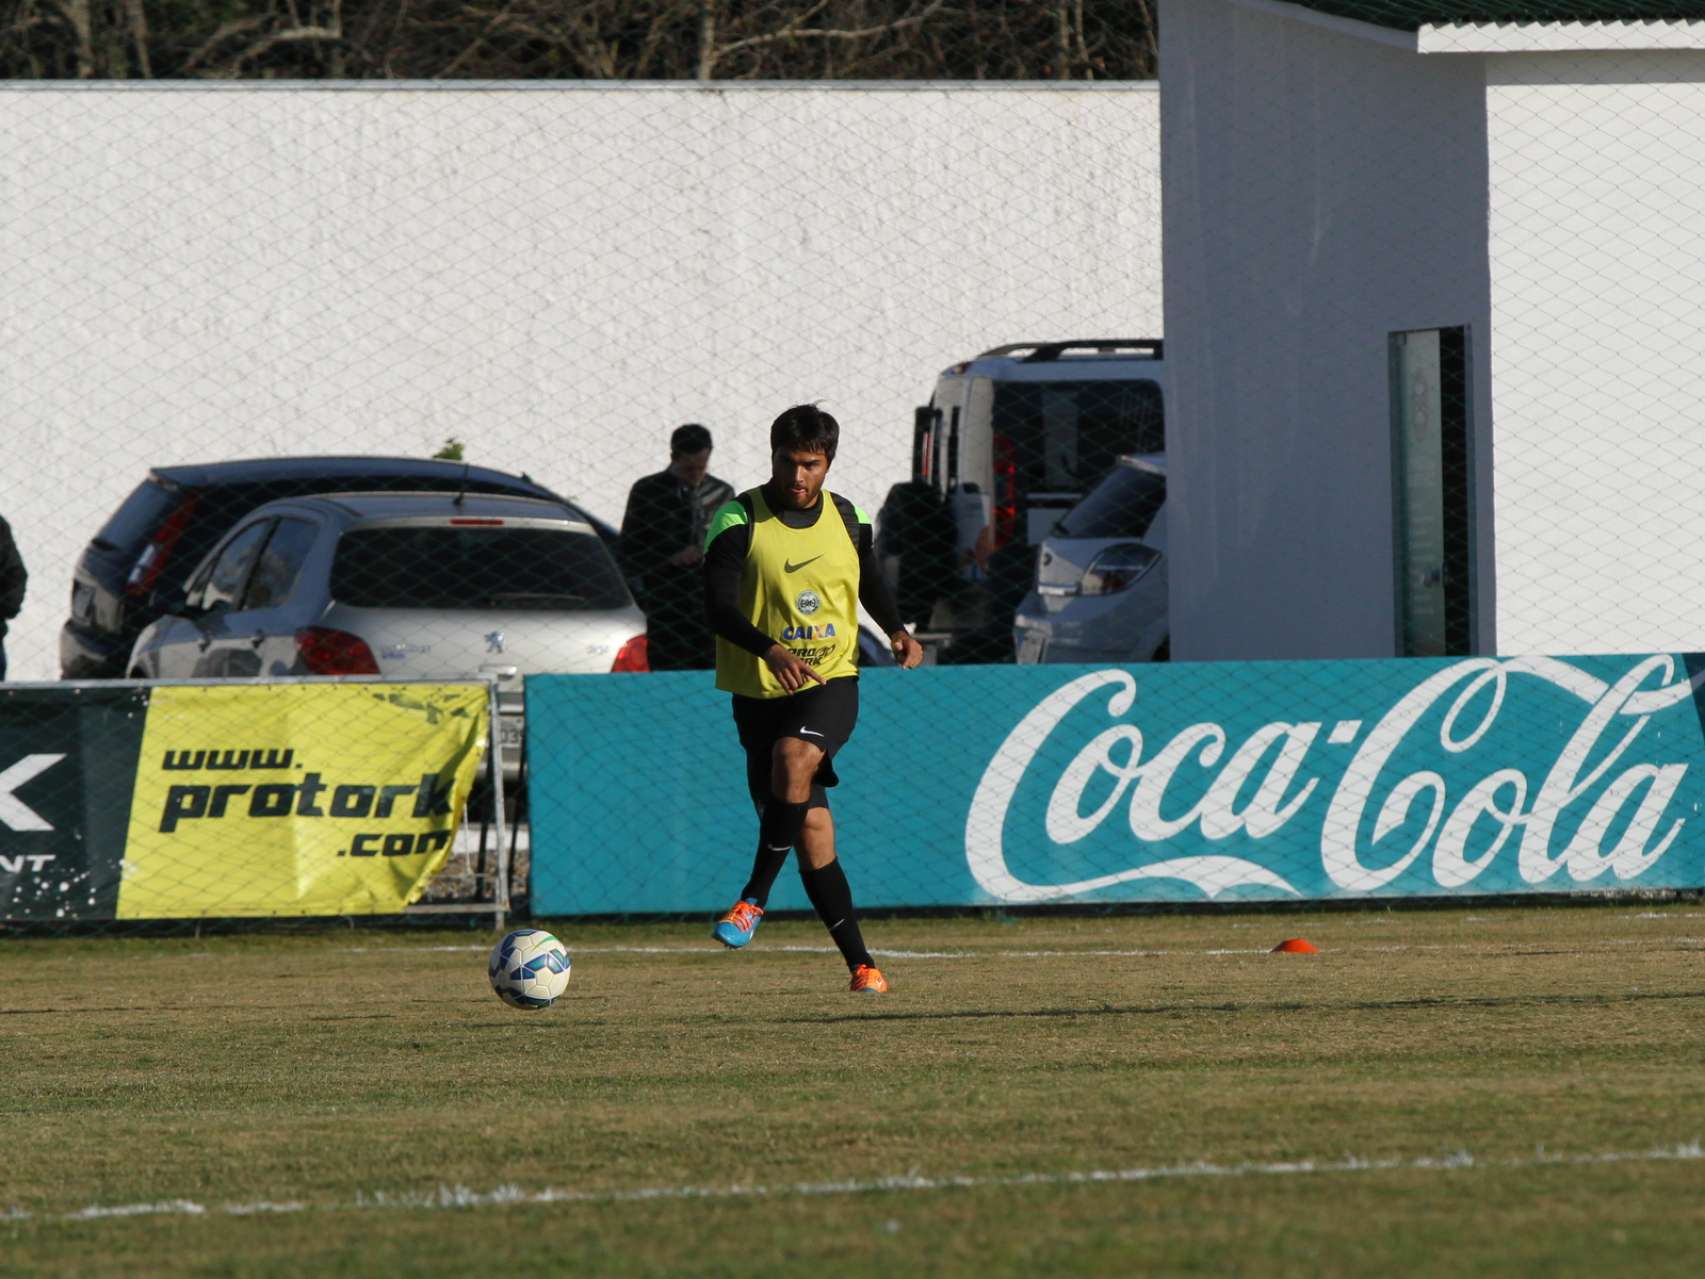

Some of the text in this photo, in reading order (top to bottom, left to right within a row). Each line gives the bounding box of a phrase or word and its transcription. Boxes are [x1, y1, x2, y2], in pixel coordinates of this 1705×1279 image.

[783, 623, 836, 641] CAIXA
[162, 748, 303, 770] www.
[965, 654, 1691, 900] Coca-Cola
[159, 772, 453, 833] protork
